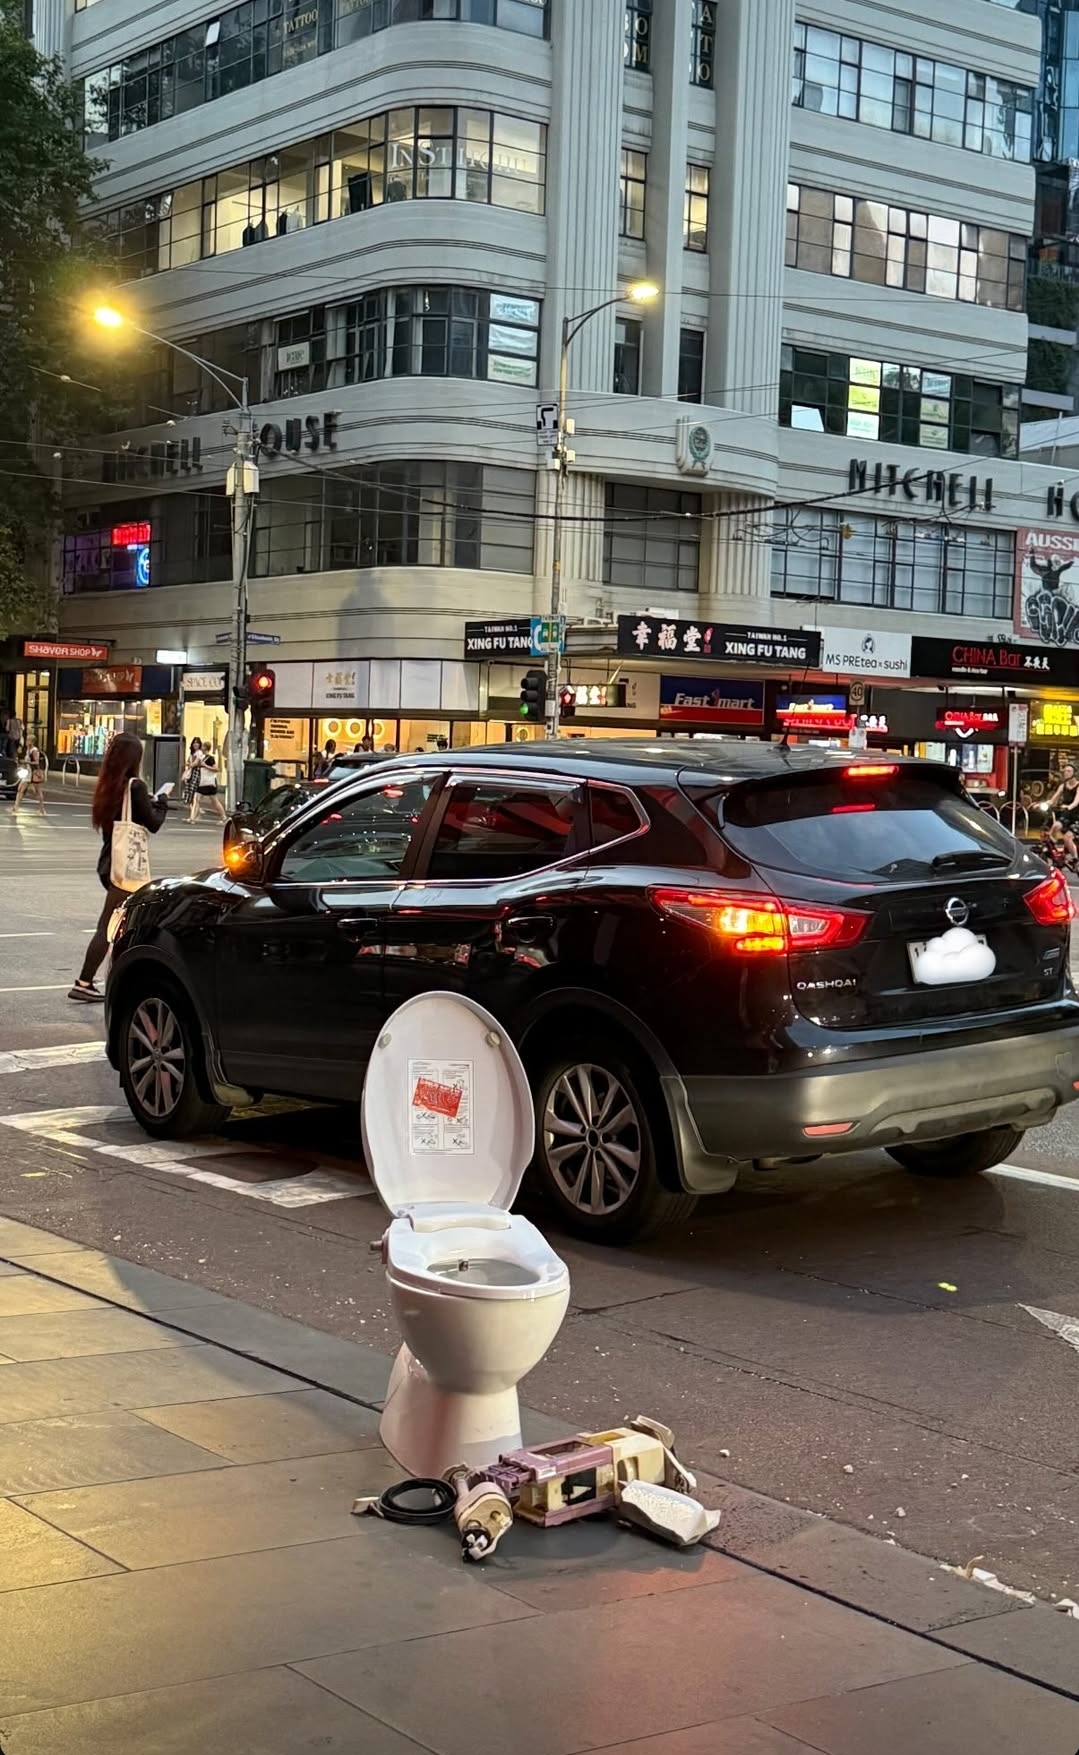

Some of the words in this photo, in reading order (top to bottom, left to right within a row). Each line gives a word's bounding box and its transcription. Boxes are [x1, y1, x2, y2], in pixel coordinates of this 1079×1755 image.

[283, 9, 319, 34] TATTOO
[259, 409, 342, 459] OUSE
[849, 458, 996, 512] MITCHELL
[69, 647, 91, 657] SHOP
[467, 637, 492, 650] XING
[493, 637, 506, 649] FU
[725, 642, 756, 656] XING
[757, 644, 773, 657] FU
[774, 645, 806, 659] TANG
[825, 654, 841, 666] MS
[883, 658, 908, 671] sushi
[952, 646, 997, 665] CHINA
[999, 649, 1022, 666] Bar
[852, 685, 864, 696] 40
[674, 693, 710, 707] Fast
